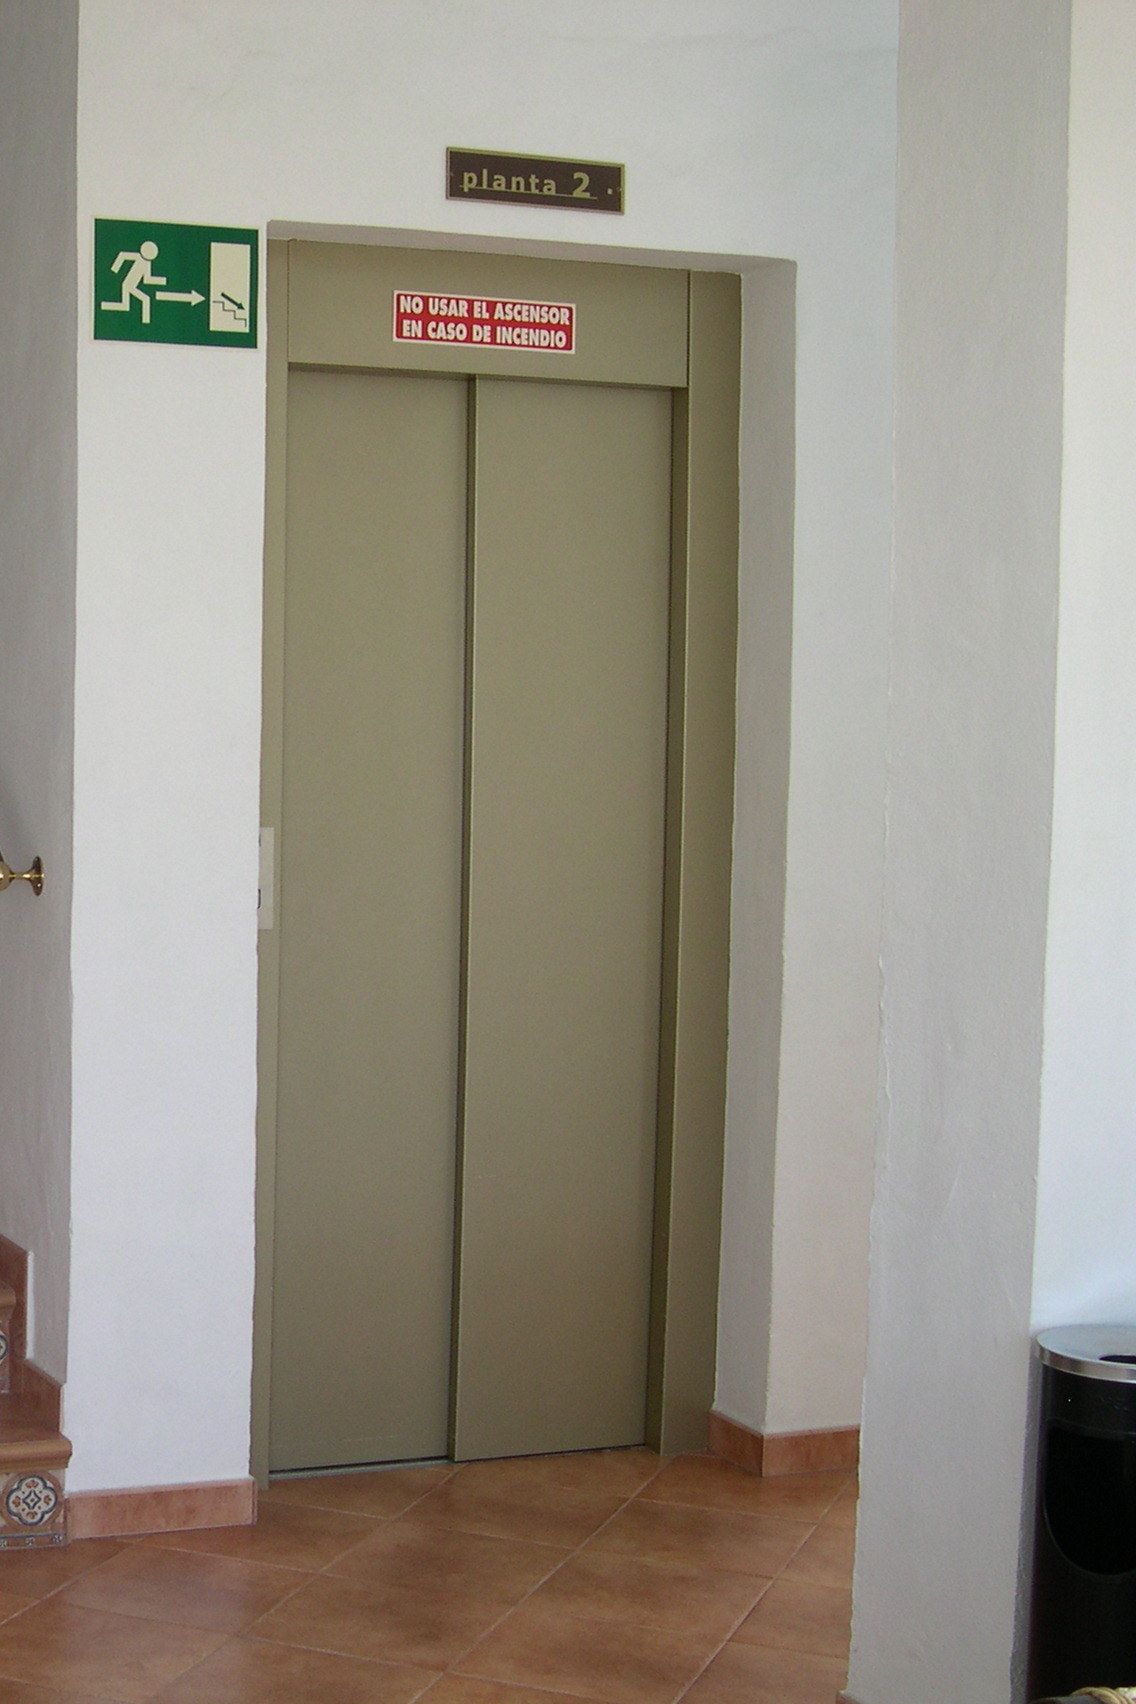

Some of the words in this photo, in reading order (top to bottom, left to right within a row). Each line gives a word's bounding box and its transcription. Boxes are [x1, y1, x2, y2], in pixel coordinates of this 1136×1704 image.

[463, 168, 556, 195] planta
[572, 172, 591, 198] 2
[399, 295, 423, 314] NO
[428, 298, 468, 318] USAR
[473, 301, 489, 319] EL
[494, 303, 570, 325] ASCENSOR
[402, 320, 422, 338] EN
[427, 321, 467, 341] CASO
[472, 324, 491, 343] DE
[496, 326, 566, 348] INCENDIO
